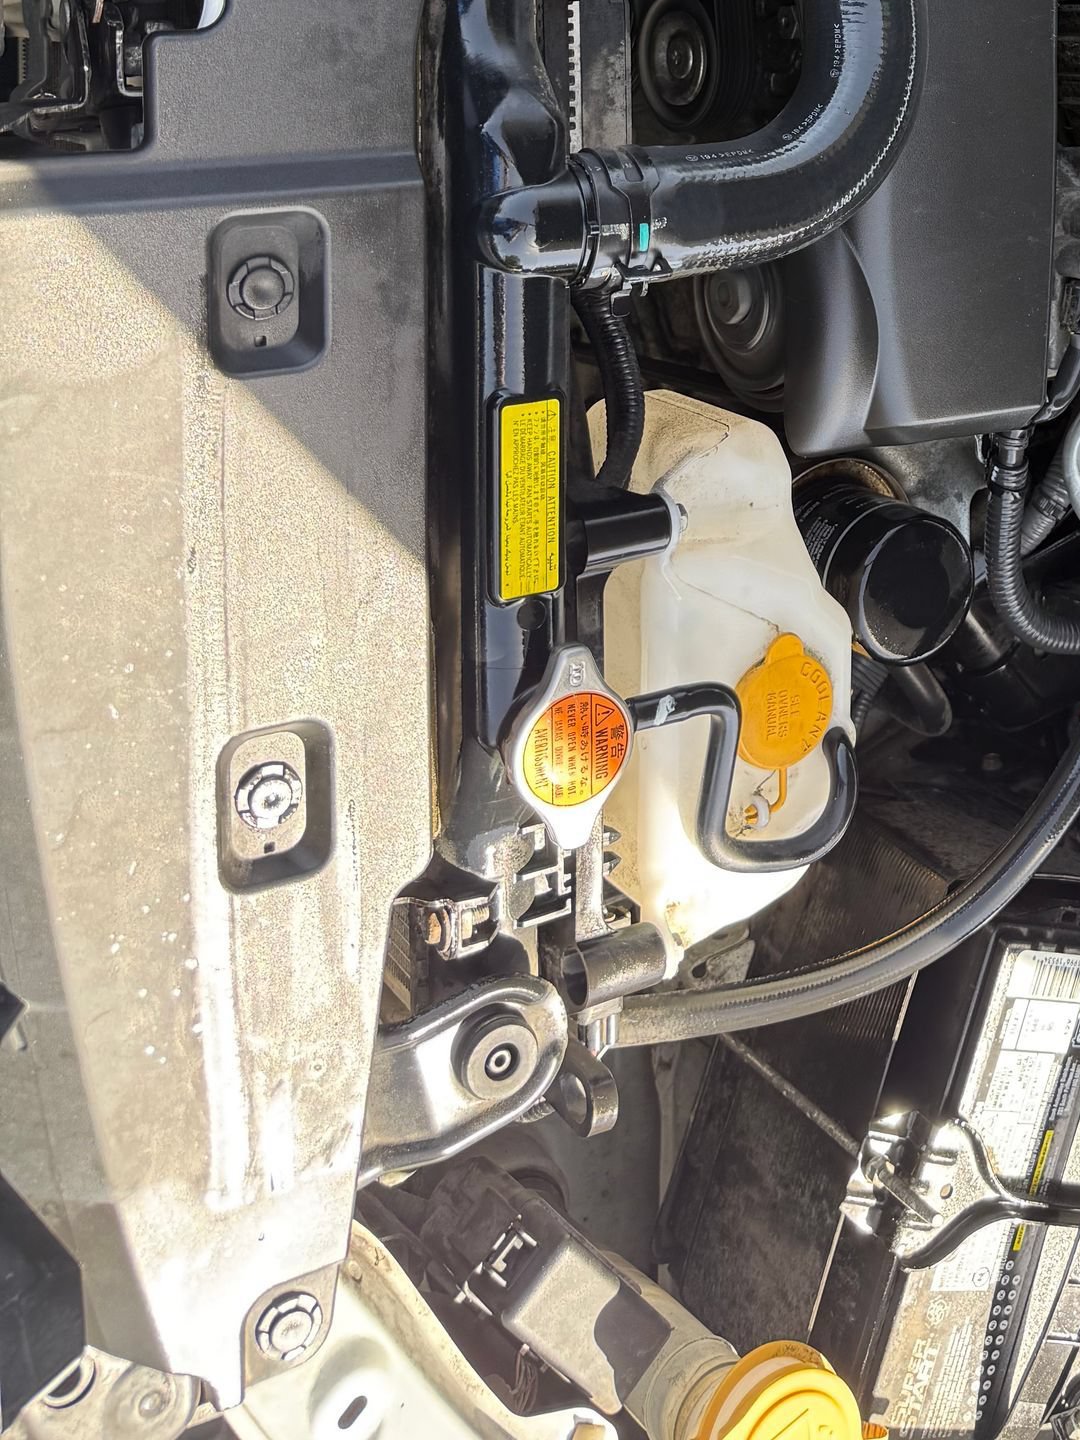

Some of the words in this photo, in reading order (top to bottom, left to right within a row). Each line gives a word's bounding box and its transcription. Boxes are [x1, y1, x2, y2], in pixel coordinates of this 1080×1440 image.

[547, 451, 557, 489] CAUTION
[547, 496, 556, 544] ATTENTION
[567, 704, 577, 728] NEVER
[567, 732, 577, 753] OPEN
[595, 727, 609, 780] WARNING
[610, 724, 625, 759] 警告
